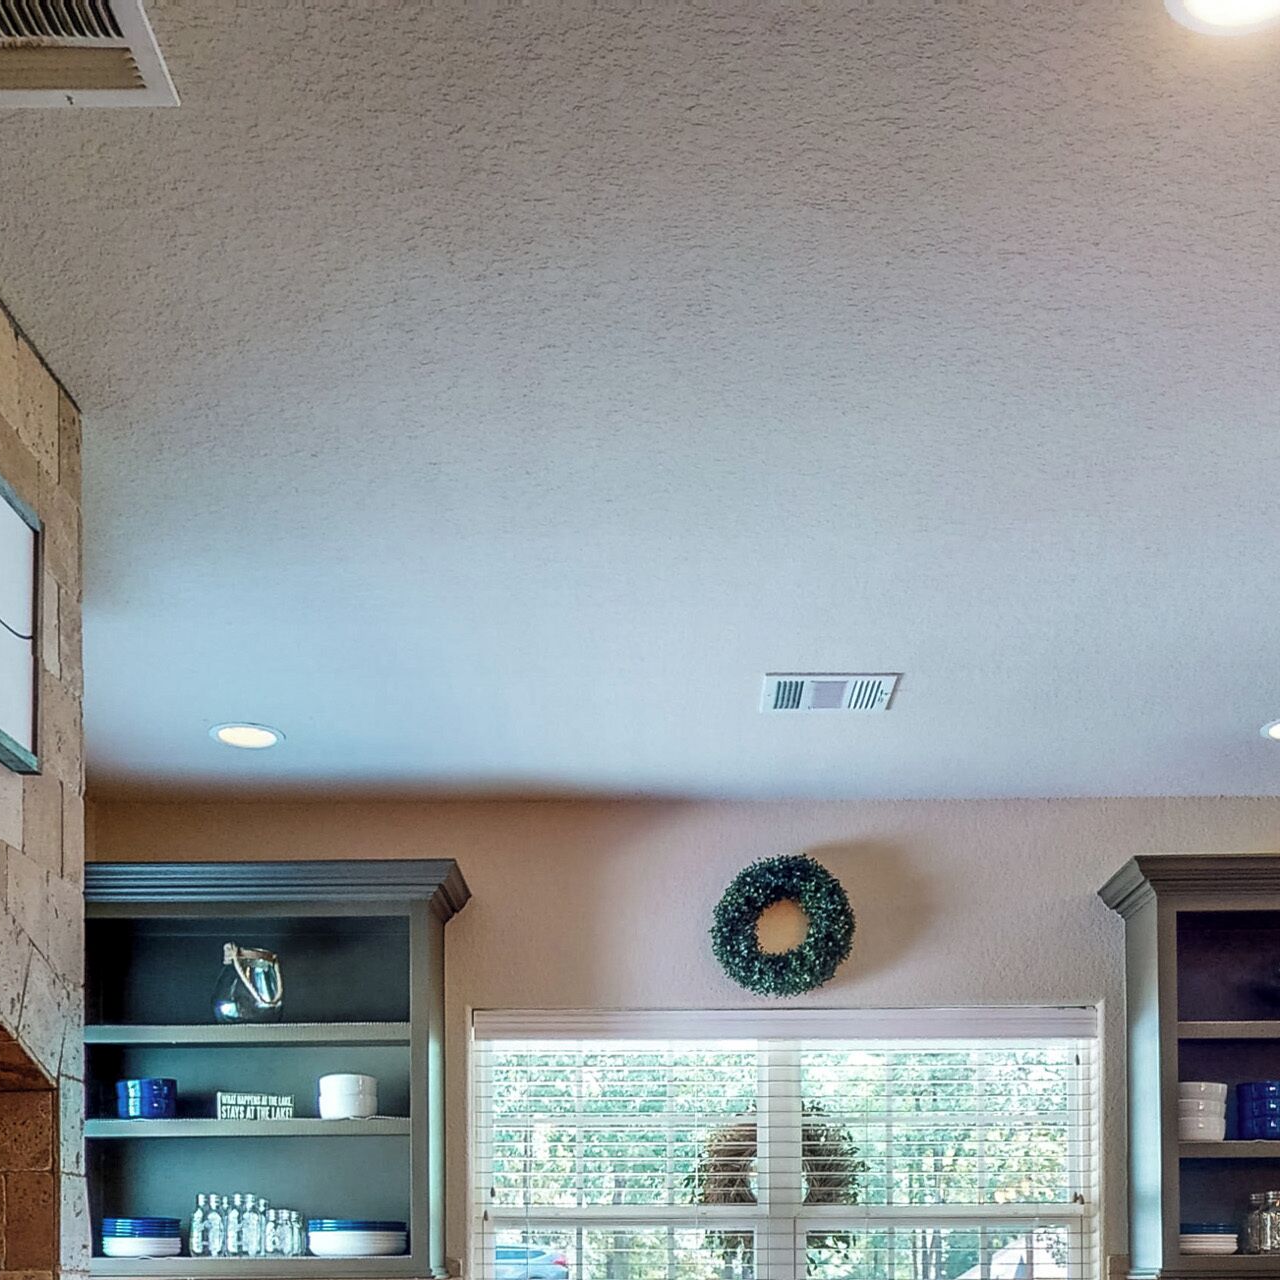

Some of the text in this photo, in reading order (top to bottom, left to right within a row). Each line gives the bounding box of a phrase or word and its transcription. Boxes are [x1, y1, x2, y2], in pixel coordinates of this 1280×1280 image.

[221, 1095, 236, 1105] WHAT
[237, 1095, 261, 1105] HAPPENS
[261, 1095, 268, 1106] AT
[269, 1096, 278, 1106] THE
[221, 1105, 245, 1119] STAYS
[246, 1106, 256, 1119] AT
[256, 1106, 270, 1120] THE
